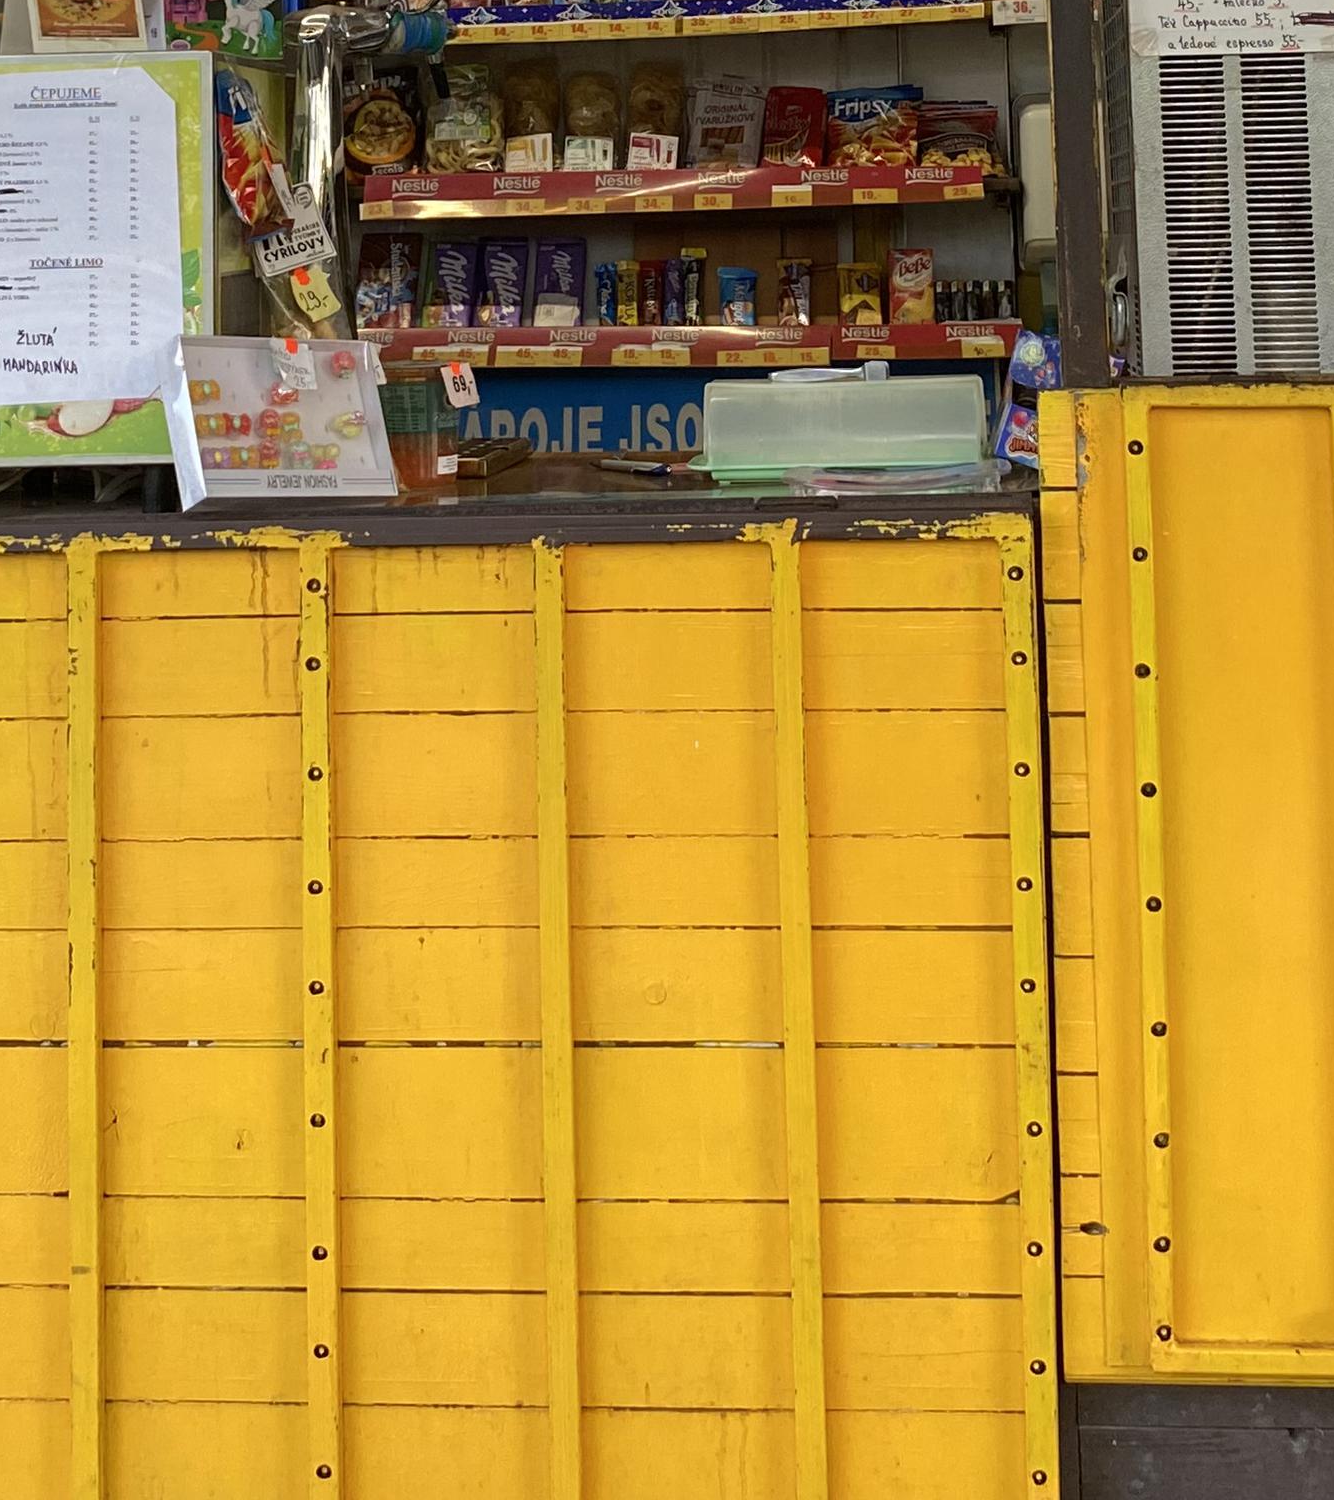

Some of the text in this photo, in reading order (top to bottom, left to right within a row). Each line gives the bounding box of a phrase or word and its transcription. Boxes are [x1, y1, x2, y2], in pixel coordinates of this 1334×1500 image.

[30, 86, 102, 100] ČEPUJEME
[264, 235, 325, 264] CYRILOVY
[29, 257, 104, 269] TOČENÉ LIMO
[16, 326, 58, 347] ŽLUTÁ
